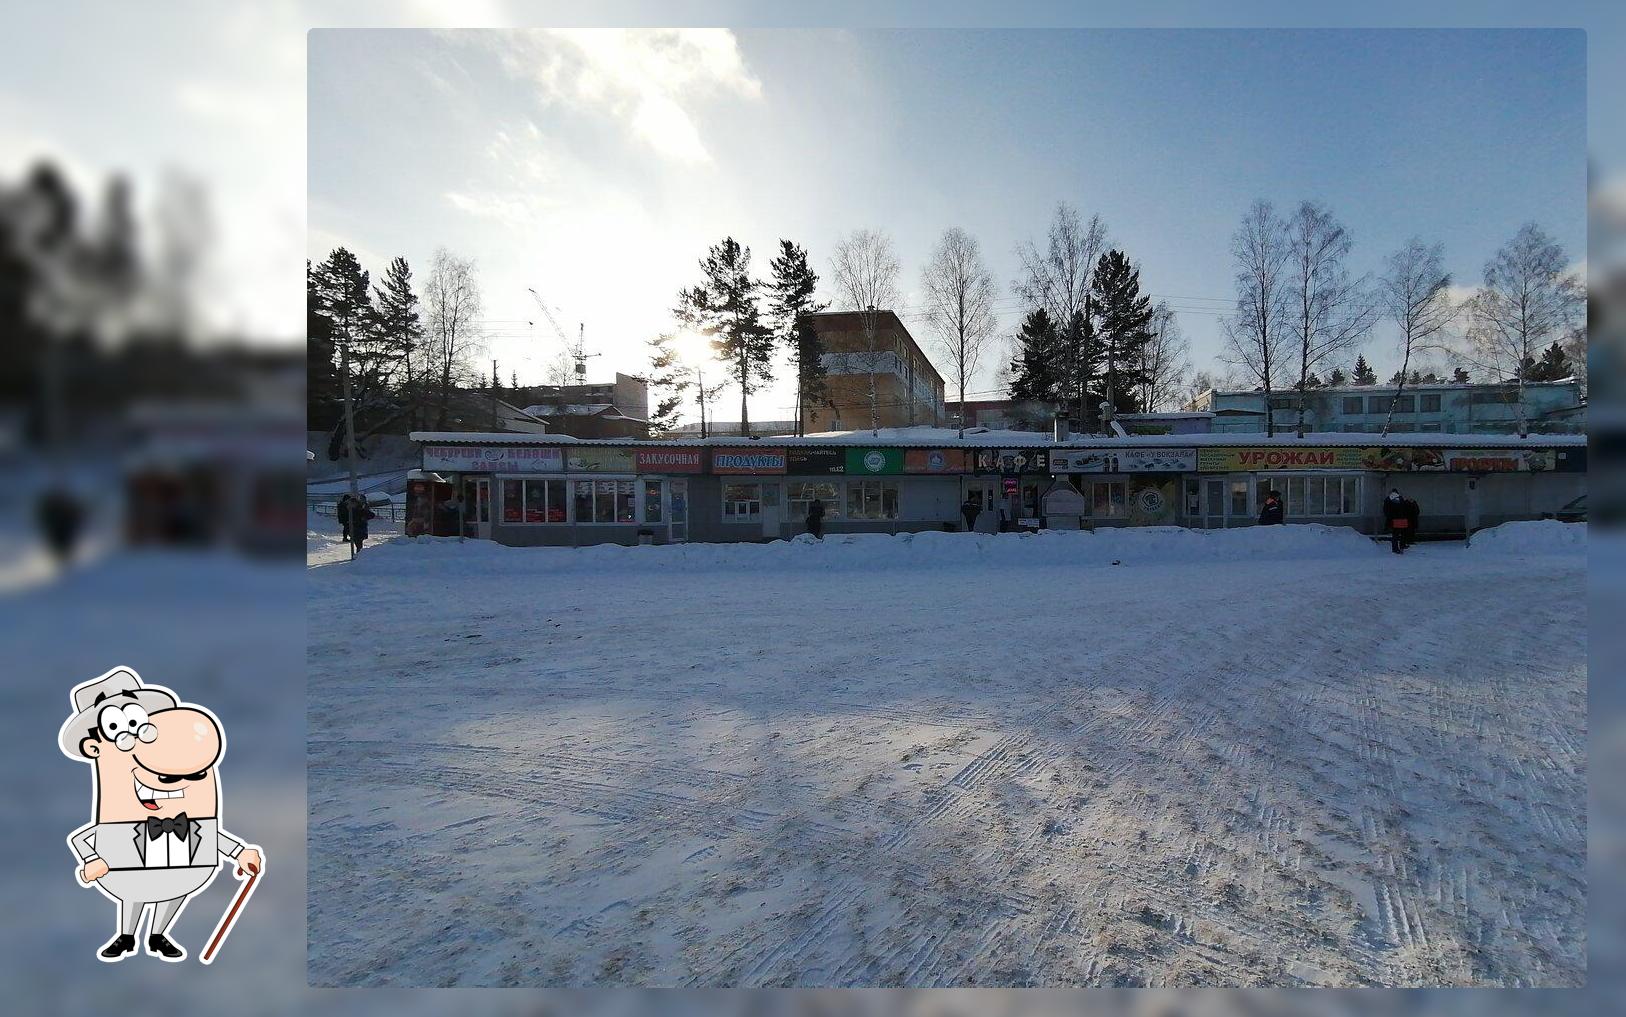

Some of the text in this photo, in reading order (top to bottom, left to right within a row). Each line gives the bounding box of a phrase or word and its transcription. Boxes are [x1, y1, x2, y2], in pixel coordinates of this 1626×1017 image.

[639, 453, 699, 465] ЗАКУСОЧНАЯ
[715, 454, 785, 468] ПРОДУКТЫ
[1238, 450, 1335, 465] УРОЖАЙ
